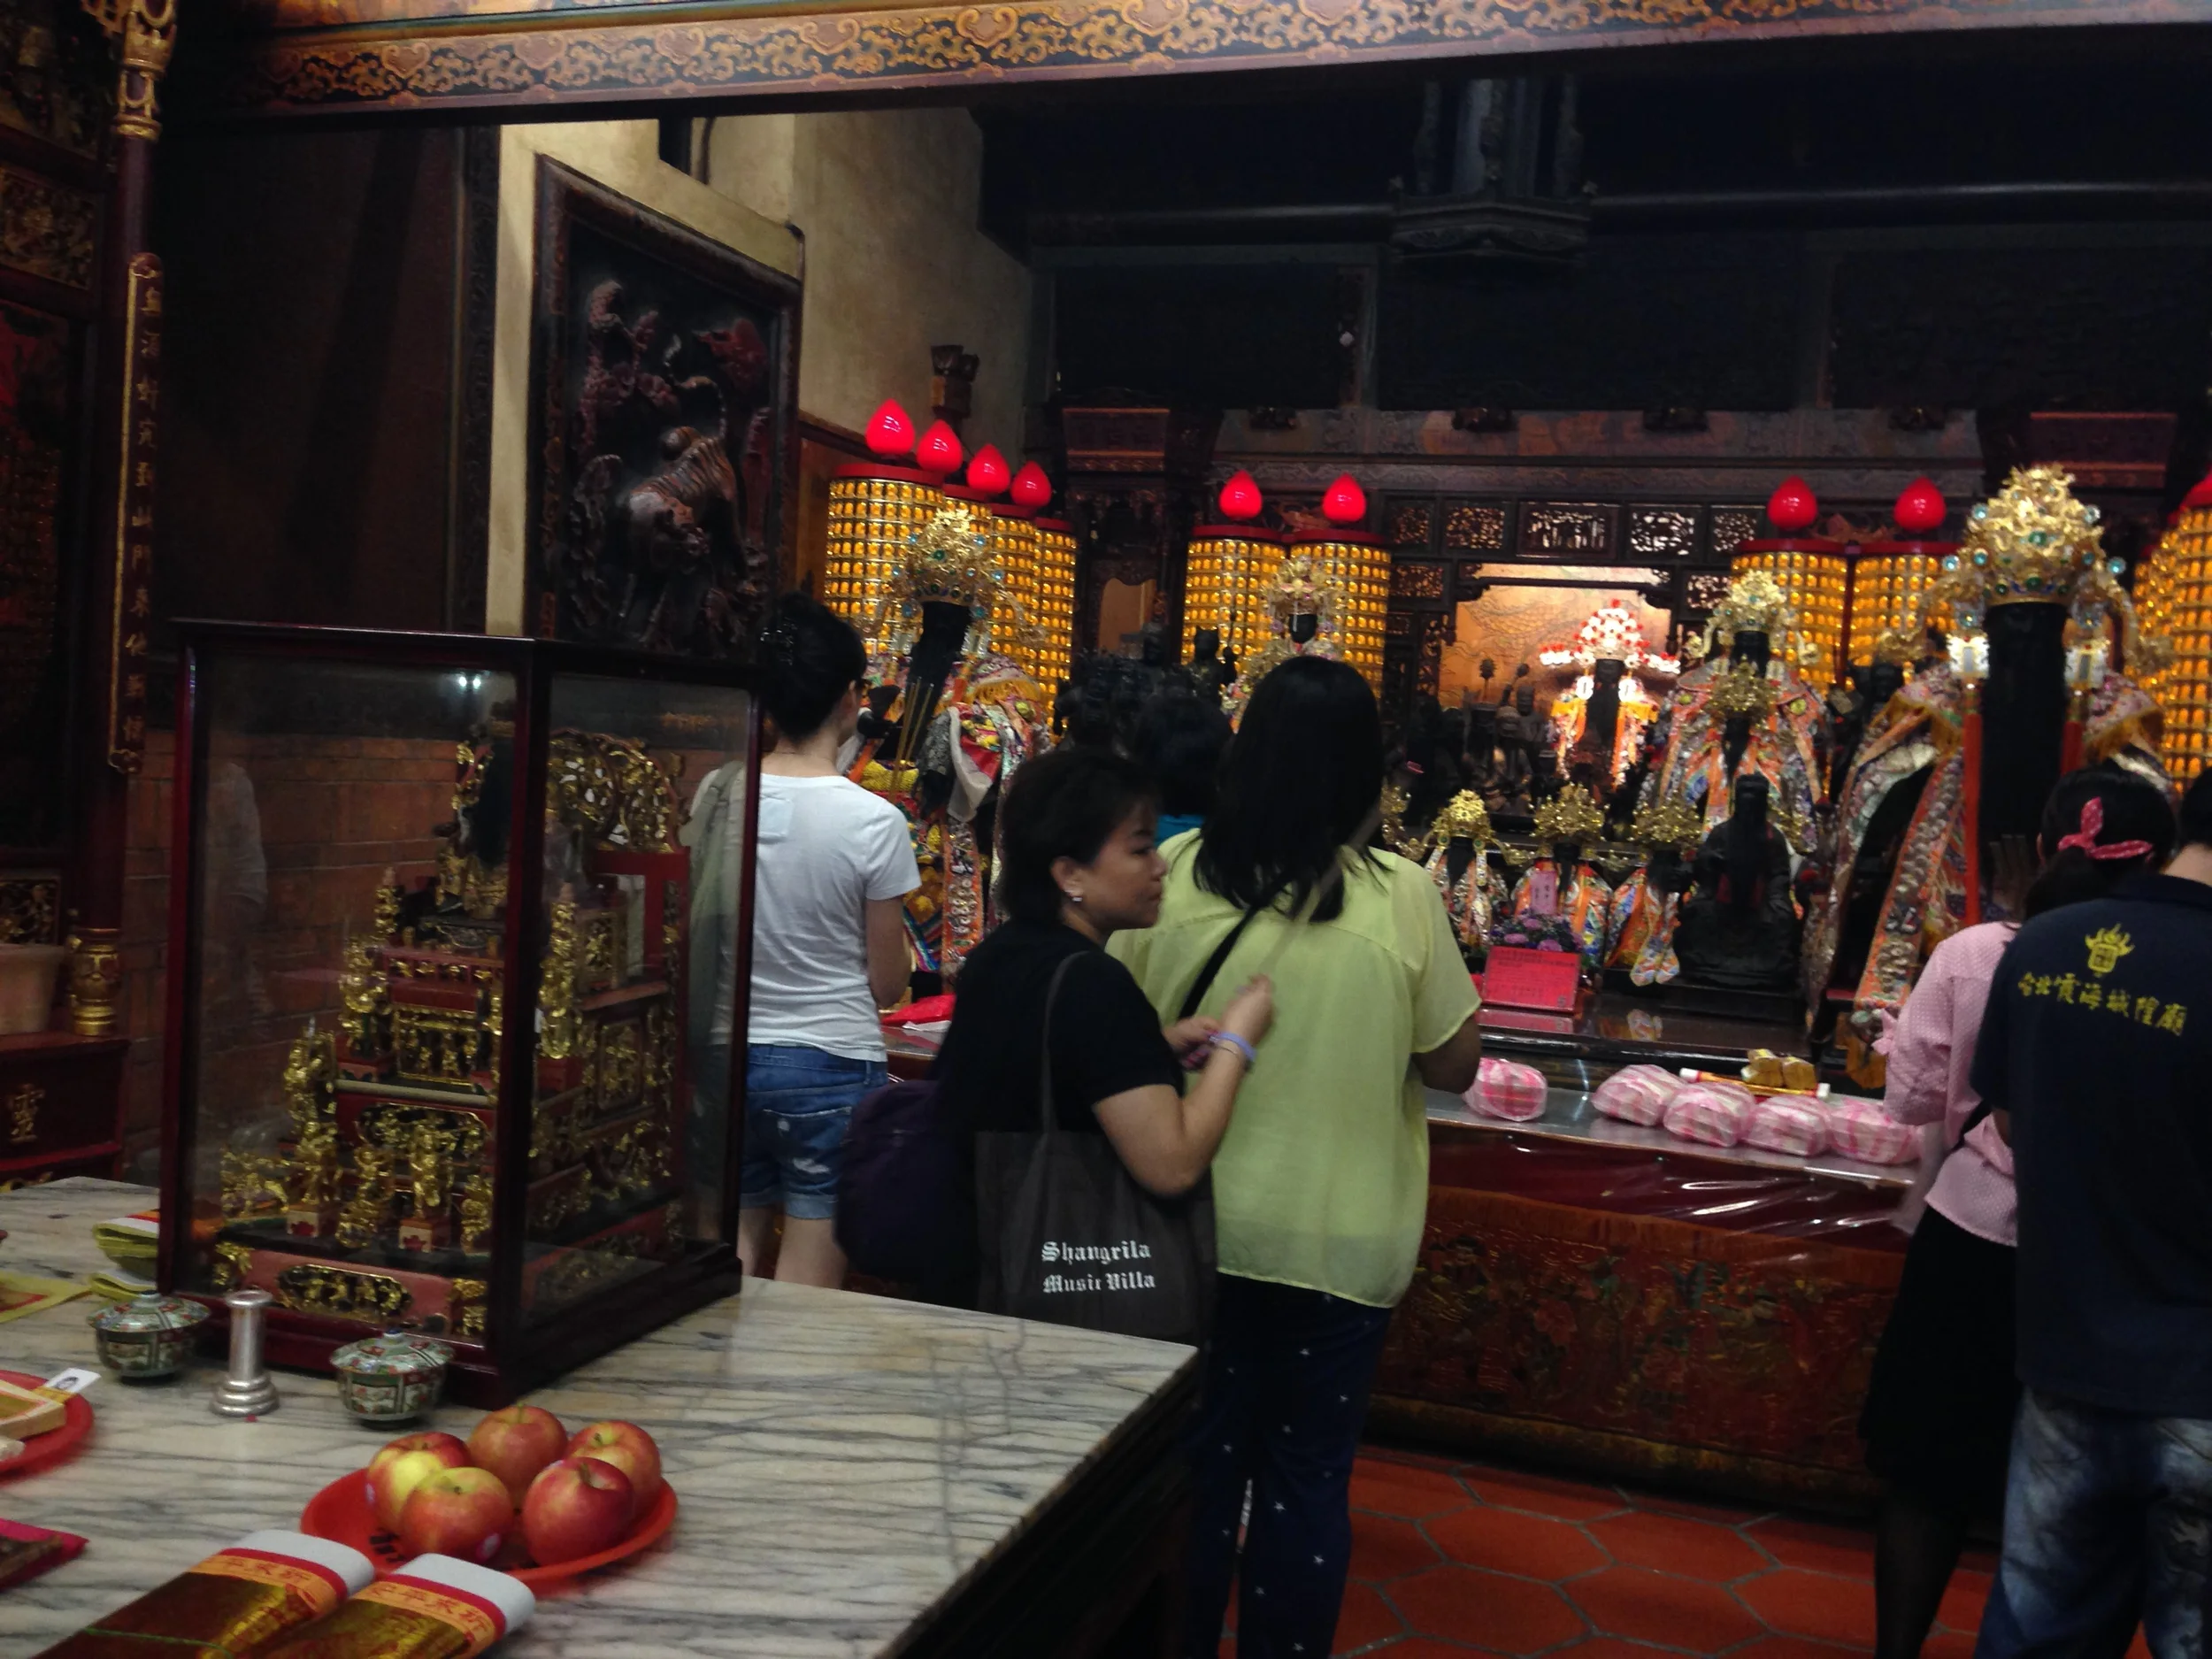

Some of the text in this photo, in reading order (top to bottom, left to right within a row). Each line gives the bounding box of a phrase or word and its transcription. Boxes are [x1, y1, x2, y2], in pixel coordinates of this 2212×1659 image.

[2017, 972, 2188, 1036] 台北霞海城隍廟
[1041, 1240, 1151, 1265] Shangrila
[1042, 1271, 1156, 1294] Music Villa
